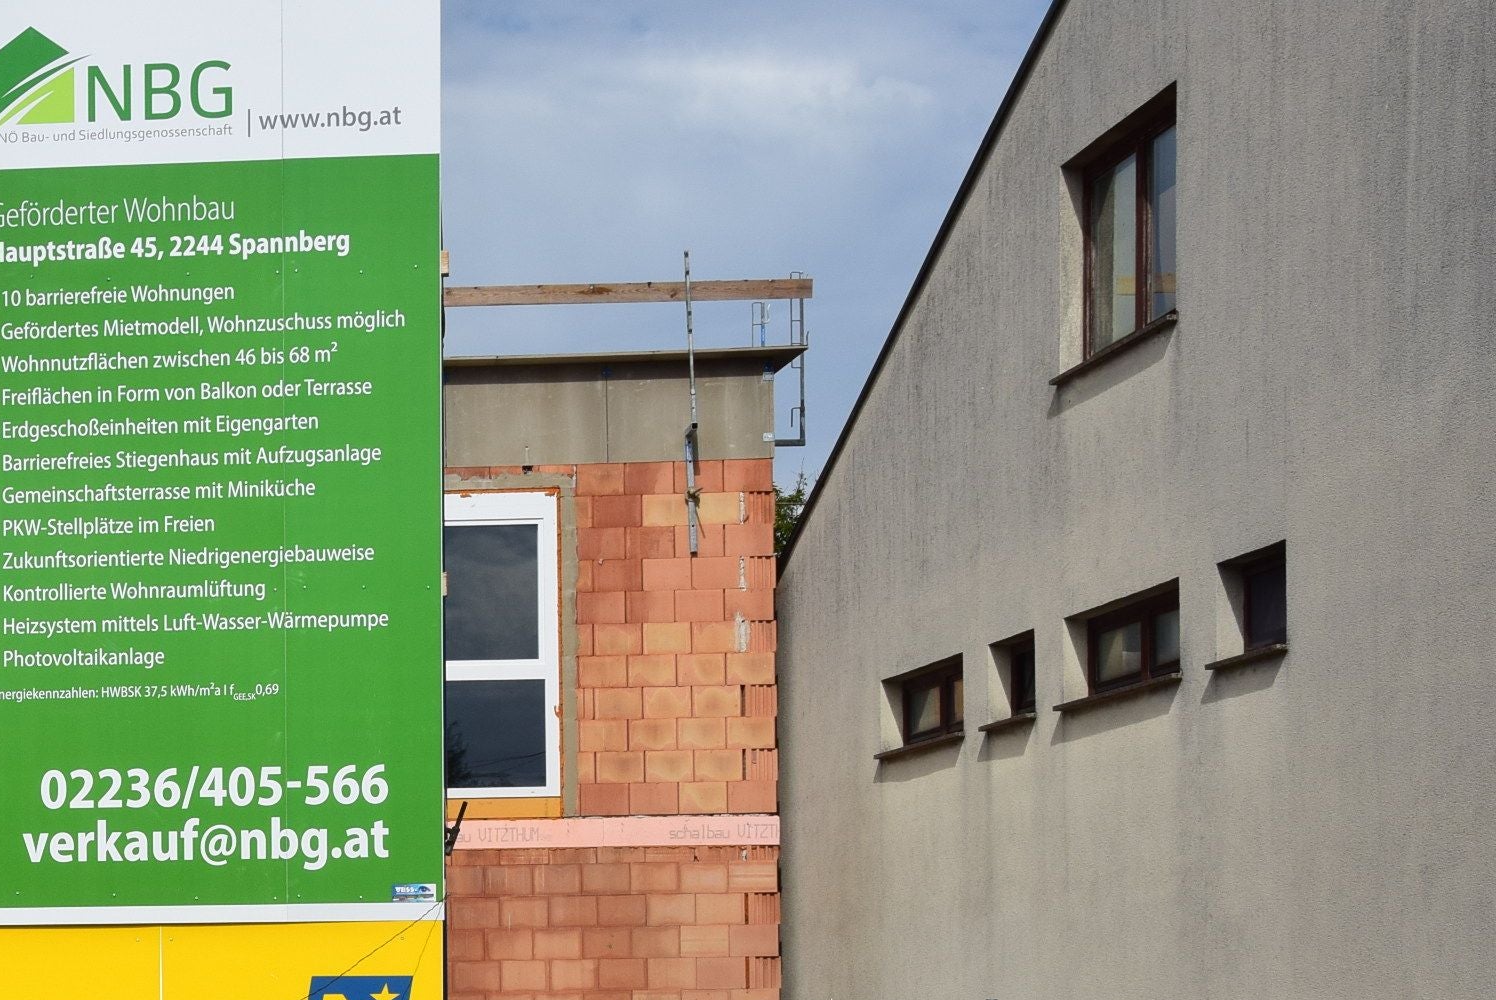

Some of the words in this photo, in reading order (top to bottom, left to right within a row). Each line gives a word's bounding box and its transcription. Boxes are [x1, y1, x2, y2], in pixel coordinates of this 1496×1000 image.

[86, 60, 234, 123] NBG
[258, 105, 402, 132] www.nbg.at
[21, 131, 50, 143] Bau-
[52, 129, 76, 142] und
[78, 123, 233, 143] Siedlungsgenossenschaft
[123, 195, 235, 223] Wohnbau
[129, 236, 164, 261] 45,
[169, 234, 224, 257] 2244
[228, 229, 350, 261] Spannberg
[1, 289, 22, 307] 10
[25, 286, 128, 307] barrierefreie
[130, 285, 235, 305] Wohnungen
[0, 320, 99, 340] Gefördertes
[103, 315, 204, 337] Mietmodell,
[206, 311, 333, 335] Wohnzuschuss
[336, 308, 406, 333] möglich
[0, 351, 149, 373] Wohnnutzflächen
[152, 348, 231, 369] zwischen
[234, 347, 257, 366] 46
[260, 342, 285, 366] bis
[288, 346, 310, 364] 68
[2, 386, 93, 406] Freiflächen
[97, 386, 113, 403] in
[117, 384, 160, 403] Form
[164, 387, 196, 401] von
[200, 380, 257, 400] Balkon
[261, 379, 302, 398] oder
[303, 378, 373, 397] Terrasse
[2, 417, 179, 443] Erdgeschoßeinheiten
[183, 415, 212, 434] mit
[216, 413, 319, 437] Eigengarten
[2, 451, 112, 472] Barrierefreies
[115, 448, 219, 472] Stiegenhaus
[223, 447, 252, 466] mit
[255, 443, 382, 468] Aufzugsanlage
[1, 483, 191, 504] Gemeinschaftsterrasse
[195, 481, 224, 499] mit
[227, 477, 316, 499] Miniküche
[2, 516, 134, 540] PKW-Stellplätze
[138, 516, 159, 534] im
[164, 515, 215, 533] Freien
[2, 549, 165, 570] Zukunftsorientierte
[169, 543, 375, 569] Niedrigenergiebauweise
[3, 582, 107, 602] Kontrollierte
[109, 578, 266, 601] Wohnraumlüftung
[3, 617, 97, 639] Heizsystem
[101, 613, 159, 633] mittels
[163, 611, 389, 635] Luft-Wasser-Wärmepumpe
[3, 646, 165, 670] Photovoltaikanlage
[101, 685, 142, 699] HWBSK
[144, 685, 168, 699] 37,5
[40, 763, 389, 810] 02236/405-566
[22, 816, 390, 871] verkauf@nbg.at
[669, 822, 730, 840] schalbau
